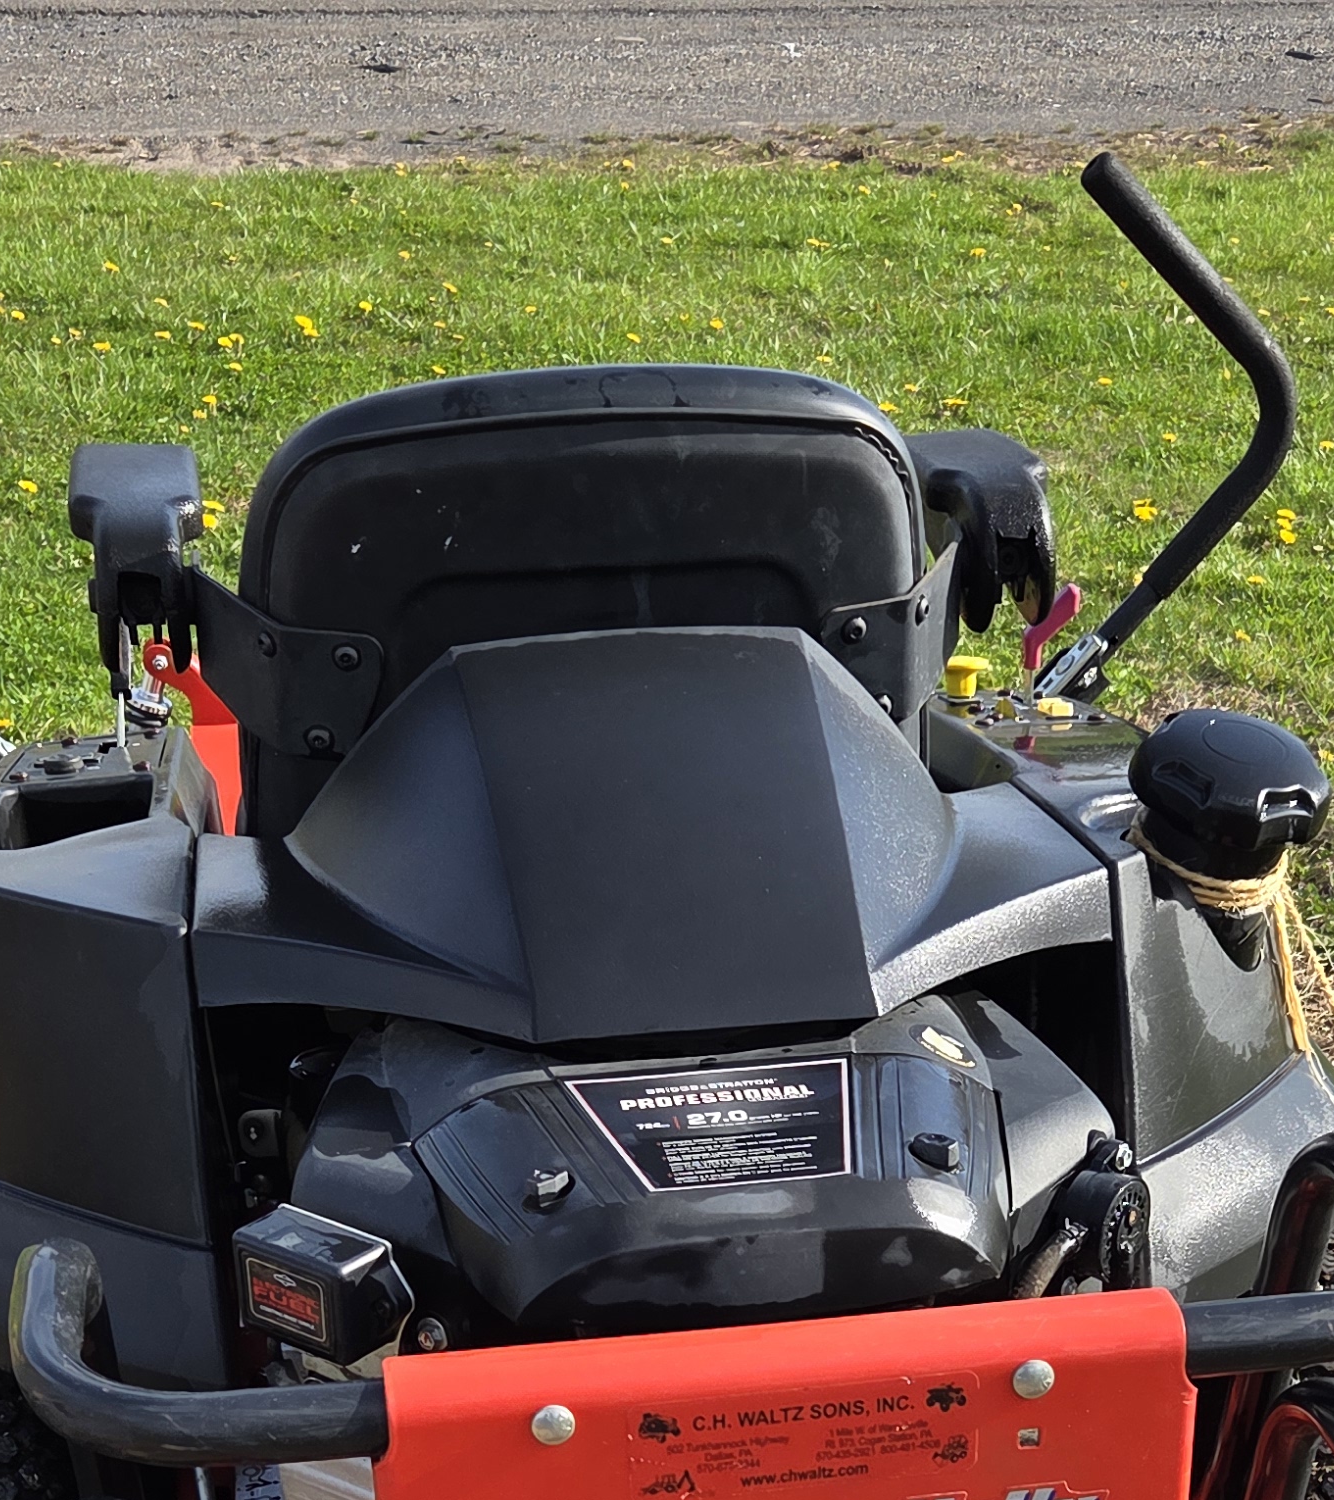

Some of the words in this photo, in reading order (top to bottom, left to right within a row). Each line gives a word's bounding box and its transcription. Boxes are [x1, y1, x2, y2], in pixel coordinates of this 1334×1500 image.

[619, 1084, 815, 1111] PROFESSIONAL
[686, 1109, 748, 1126] 27.0
[254, 1285, 320, 1321] FUEL
[692, 1413, 732, 1431] C.H.
[737, 1406, 804, 1427] WALTZ
[809, 1400, 870, 1420] SONS,
[876, 1394, 915, 1413] INC.
[740, 1463, 869, 1487] www.chwaltz.com
